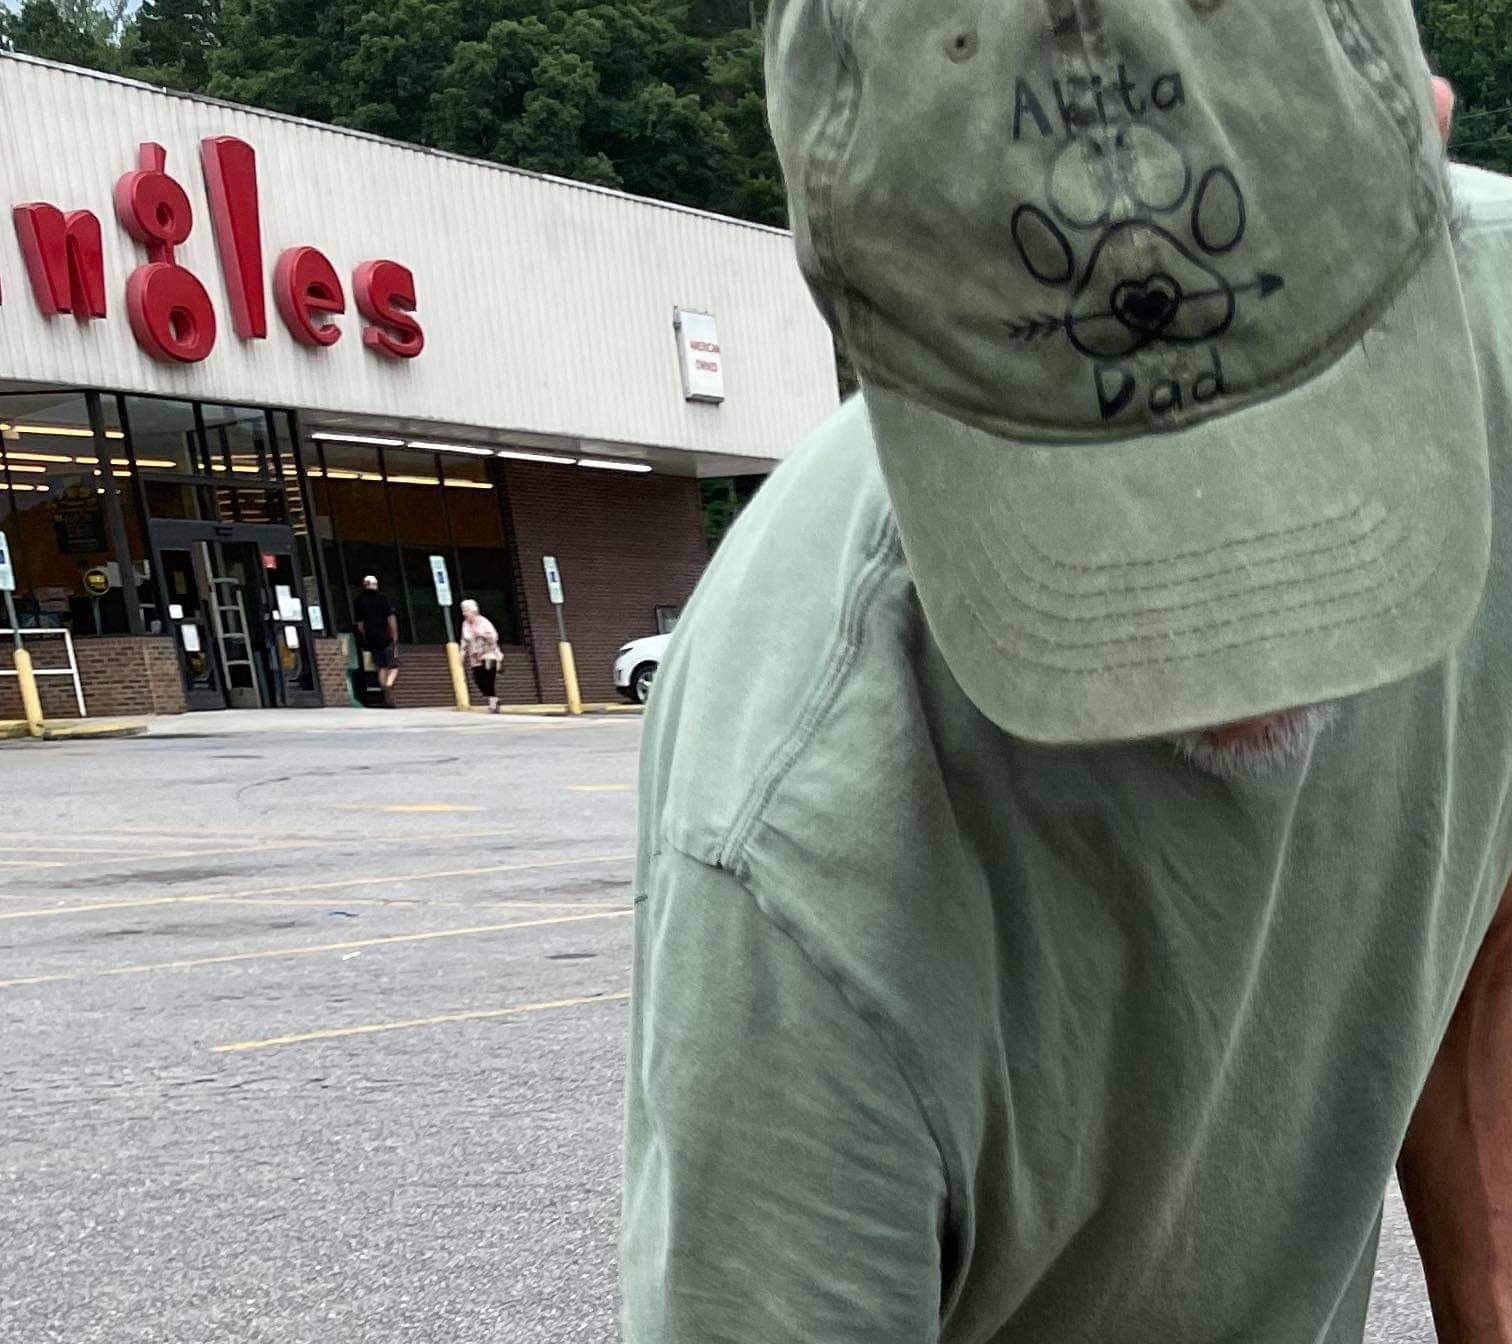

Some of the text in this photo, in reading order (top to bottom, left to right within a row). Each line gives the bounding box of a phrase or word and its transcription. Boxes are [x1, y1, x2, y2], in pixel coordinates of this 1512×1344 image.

[1011, 63, 1186, 141] Akita
[0, 134, 426, 364] ngles
[1093, 343, 1227, 420] Dad
